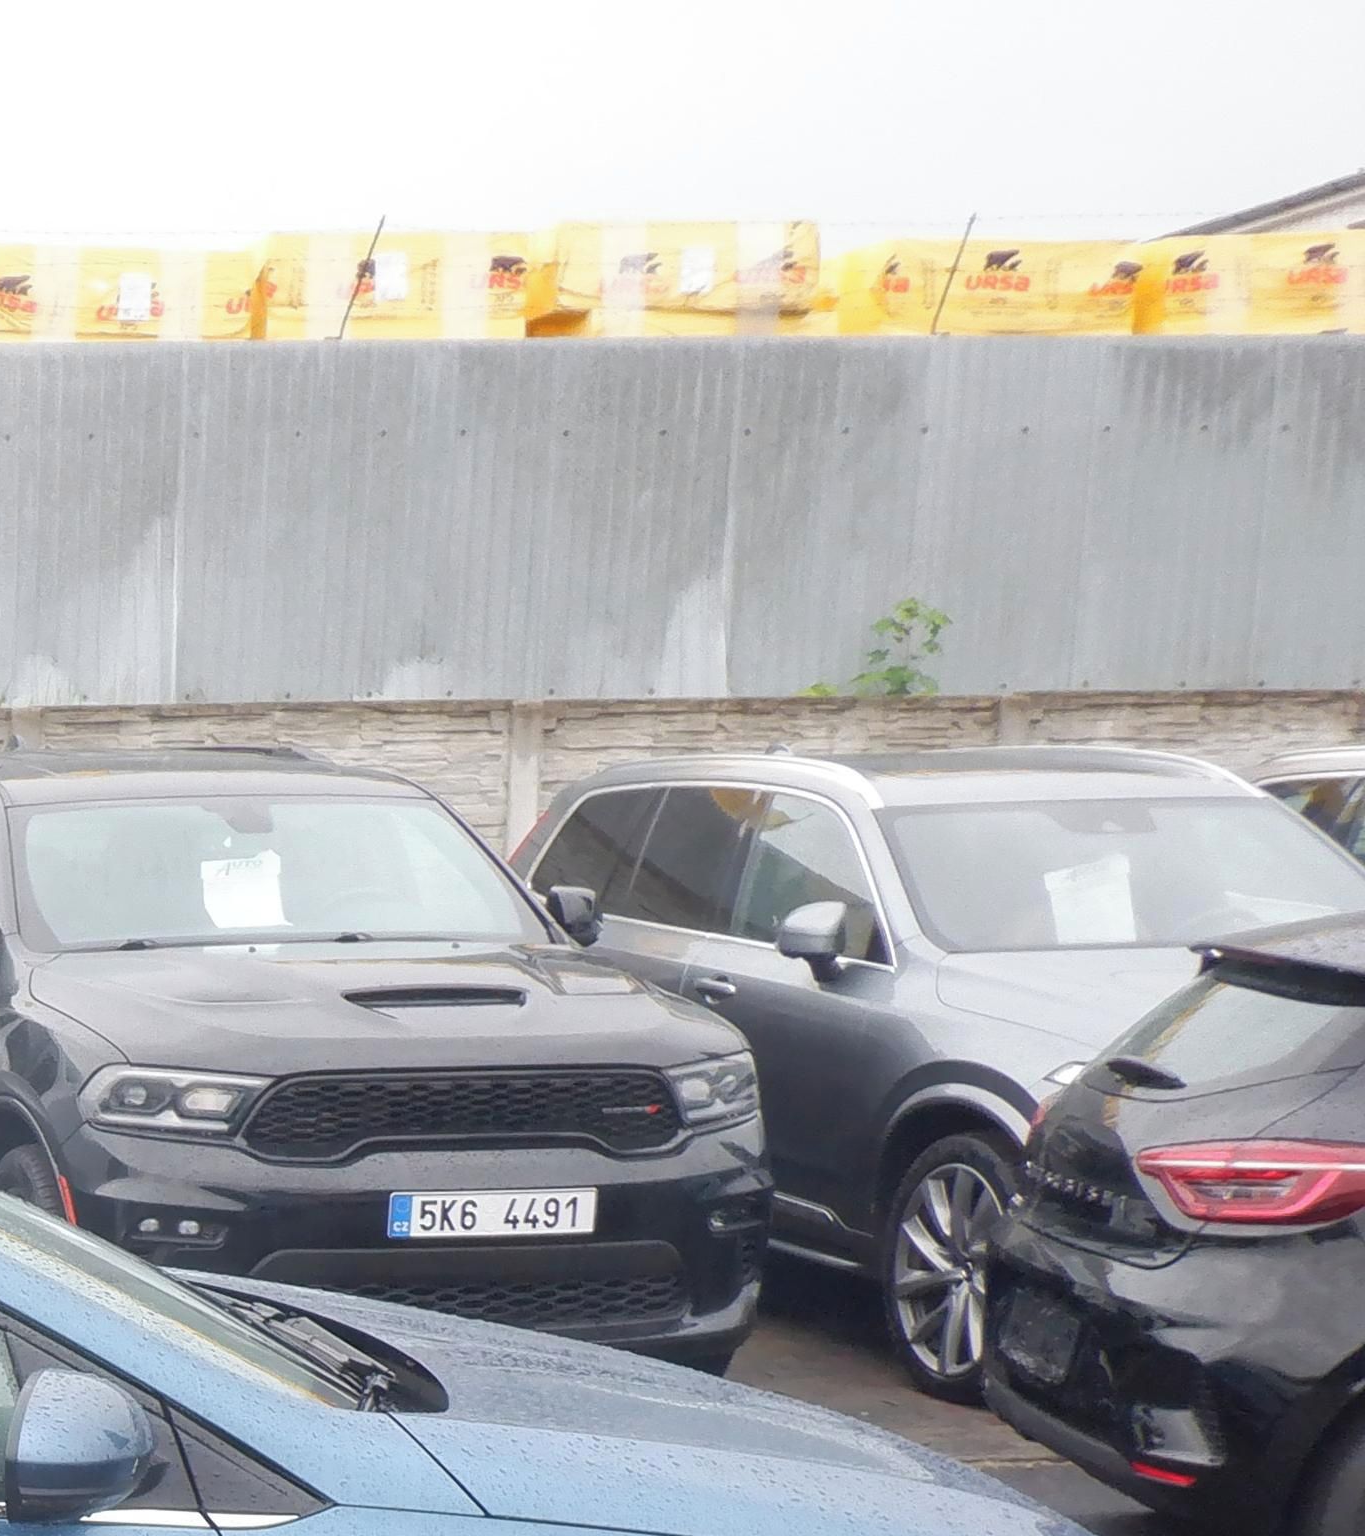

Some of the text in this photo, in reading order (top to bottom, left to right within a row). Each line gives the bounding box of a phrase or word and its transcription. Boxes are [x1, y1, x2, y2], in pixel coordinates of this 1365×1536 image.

[419, 1197, 578, 1231] 5K6 4491
[393, 1221, 409, 1232] CZ
